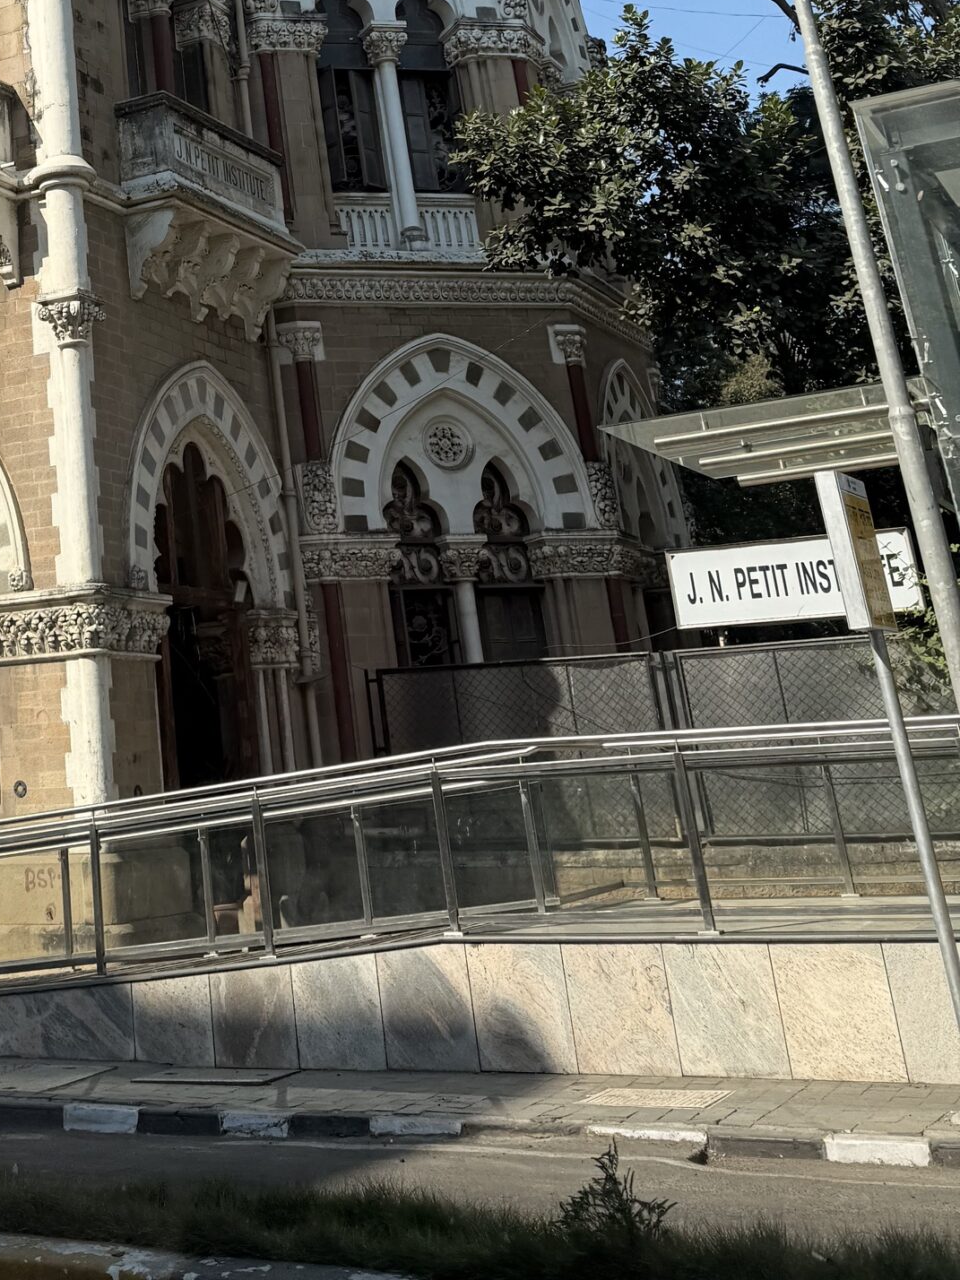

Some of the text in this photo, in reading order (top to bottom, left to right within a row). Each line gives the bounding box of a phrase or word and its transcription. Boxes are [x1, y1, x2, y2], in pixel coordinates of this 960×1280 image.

[223, 160, 266, 201] INSTITUTE
[687, 572, 703, 605] J.
[708, 570, 730, 602] N.
[735, 563, 789, 600] PETIT
